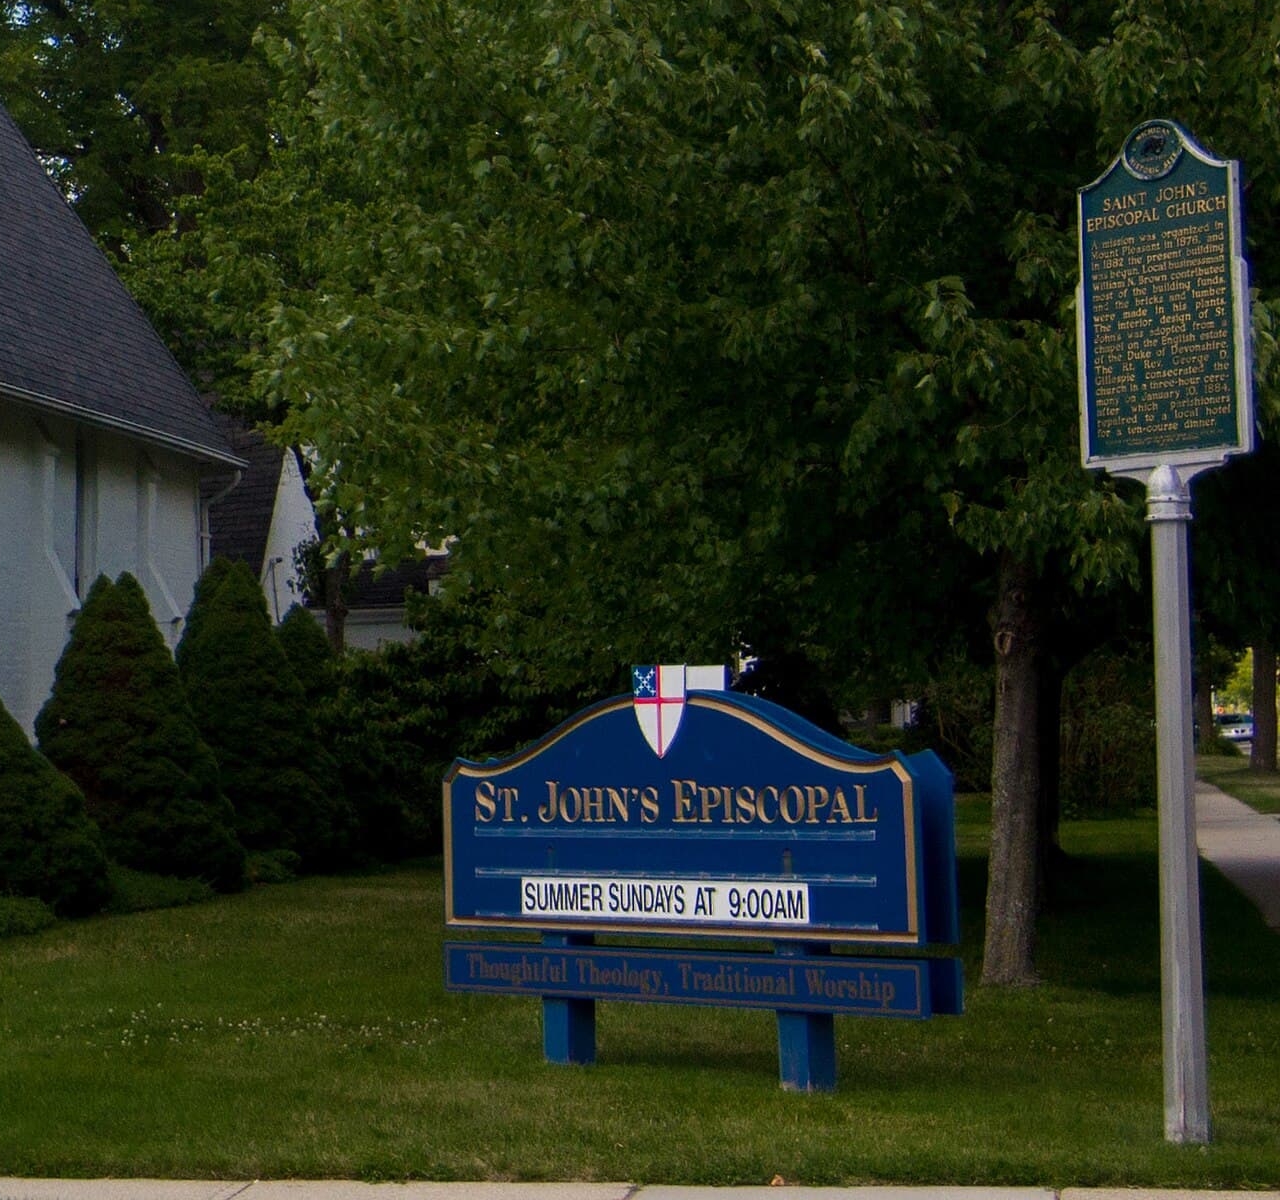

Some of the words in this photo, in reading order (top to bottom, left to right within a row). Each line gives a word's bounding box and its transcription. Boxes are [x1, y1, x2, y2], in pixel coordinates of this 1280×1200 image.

[1103, 191, 1147, 212] SAINT
[1156, 181, 1208, 203] JOHN'S
[1087, 207, 1160, 233] EPISCOPAL
[1166, 195, 1227, 219] CHURCH
[1091, 241, 1098, 250] A
[1102, 235, 1135, 249] mission
[1139, 233, 1156, 241] was
[1161, 224, 1209, 240] organized
[1214, 220, 1224, 230] in
[1091, 249, 1119, 260] Mount
[1121, 243, 1160, 257] Pleasant
[1163, 239, 1173, 249] in
[1206, 232, 1225, 243] and
[1091, 262, 1100, 272] in
[1103, 258, 1124, 269] 1882
[1128, 255, 1142, 265] the
[1146, 250, 1181, 264] present
[1186, 243, 1224, 257] building
[1142, 262, 1167, 274] Local
[1138, 274, 1168, 285] Brown
[1170, 264, 1225, 280] contributed
[1092, 292, 1113, 302] most
[1119, 289, 1128, 298] of
[1132, 287, 1147, 297] the
[1152, 281, 1191, 294] building
[1115, 300, 1129, 310] the
[1135, 295, 1163, 307] bricks
[1169, 291, 1186, 301] and
[1192, 286, 1226, 299] lumber
[1092, 313, 1116, 323] were
[1123, 307, 1148, 320] made
[1155, 305, 1164, 315] in
[1172, 302, 1187, 312] his
[1093, 323, 1111, 333] The
[1118, 319, 1153, 330] interior
[1159, 313, 1192, 325] design
[1198, 308, 1209, 319] of
[1192, 319, 1216, 330] from
[1127, 341, 1140, 351] on
[1143, 337, 1158, 347] the
[1161, 333, 1196, 347] English
[1094, 355, 1104, 365] of
[1108, 352, 1122, 362] the
[1127, 350, 1152, 360] Duke
[1155, 347, 1165, 357] of
[1095, 364, 1113, 374] The
[1172, 354, 1210, 367] George
[1145, 361, 1205, 380] consecrated
[1213, 361, 1230, 371] the
[1096, 383, 1127, 396] church
[1130, 382, 1138, 392] in
[1141, 382, 1147, 390] a
[1142, 390, 1180, 402] January
[1096, 407, 1120, 417] after
[1131, 402, 1158, 414] which
[1170, 395, 1231, 411] parishioners
[1144, 413, 1155, 422] to
[1161, 413, 1168, 421] a
[1174, 407, 1199, 419] local
[1205, 404, 1231, 416] hotel
[1097, 428, 1111, 438] for
[1127, 421, 1179, 435] ten-course
[538, 780, 659, 824] JOHN'S
[670, 779, 879, 825] EPISCOPAL
[524, 882, 603, 913] SUMMER
[608, 884, 685, 915] SUNDAYS
[693, 887, 717, 917] AT
[728, 889, 805, 920] 9:00AM
[467, 953, 568, 986] Thoughtful
[576, 957, 670, 997] Theology,
[680, 964, 796, 998] Traditional
[806, 969, 895, 1004] Worship
